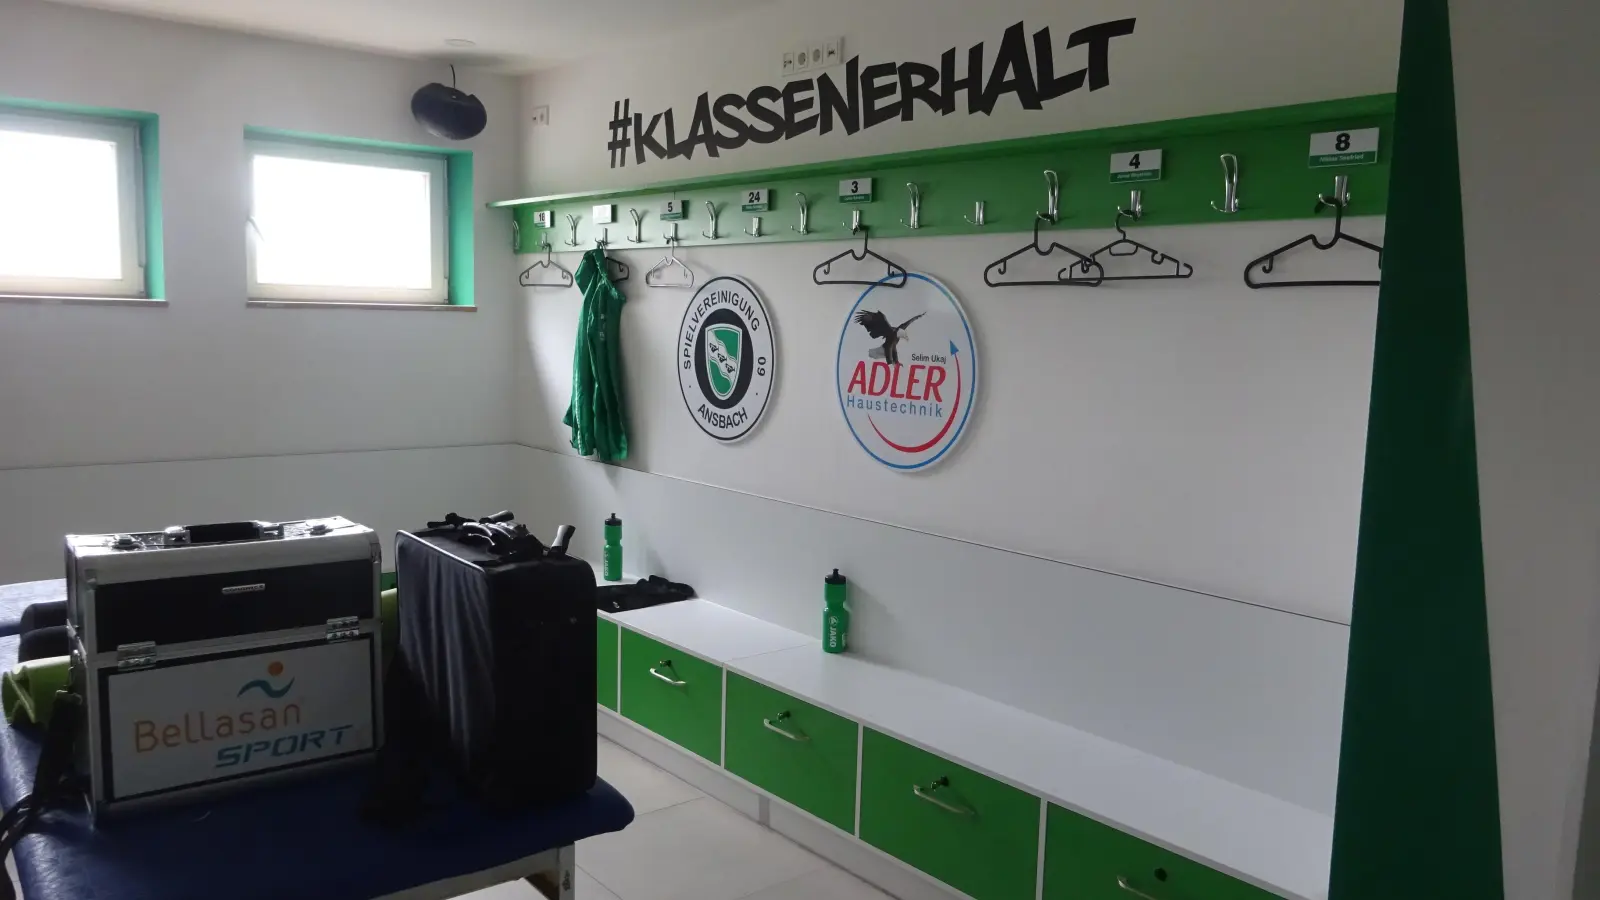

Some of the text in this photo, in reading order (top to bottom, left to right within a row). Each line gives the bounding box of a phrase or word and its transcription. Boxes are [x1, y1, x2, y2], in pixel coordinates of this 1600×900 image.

[607, 17, 1137, 169] #KLASSENERHALT
[1335, 132, 1351, 152] 8
[1128, 153, 1141, 170] 4
[748, 191, 761, 204] 24
[851, 180, 859, 194] 3
[667, 201, 673, 212] 5
[683, 290, 760, 370] SPIELVEREINIGUNG
[911, 353, 947, 365] Selim Ukaj
[847, 360, 947, 403] ADLER
[697, 403, 749, 429] ANSBACH
[846, 394, 943, 418] Haustechnik
[829, 626, 837, 648] JAKO
[134, 703, 301, 754] Bellasan
[215, 724, 354, 769] SPORT
